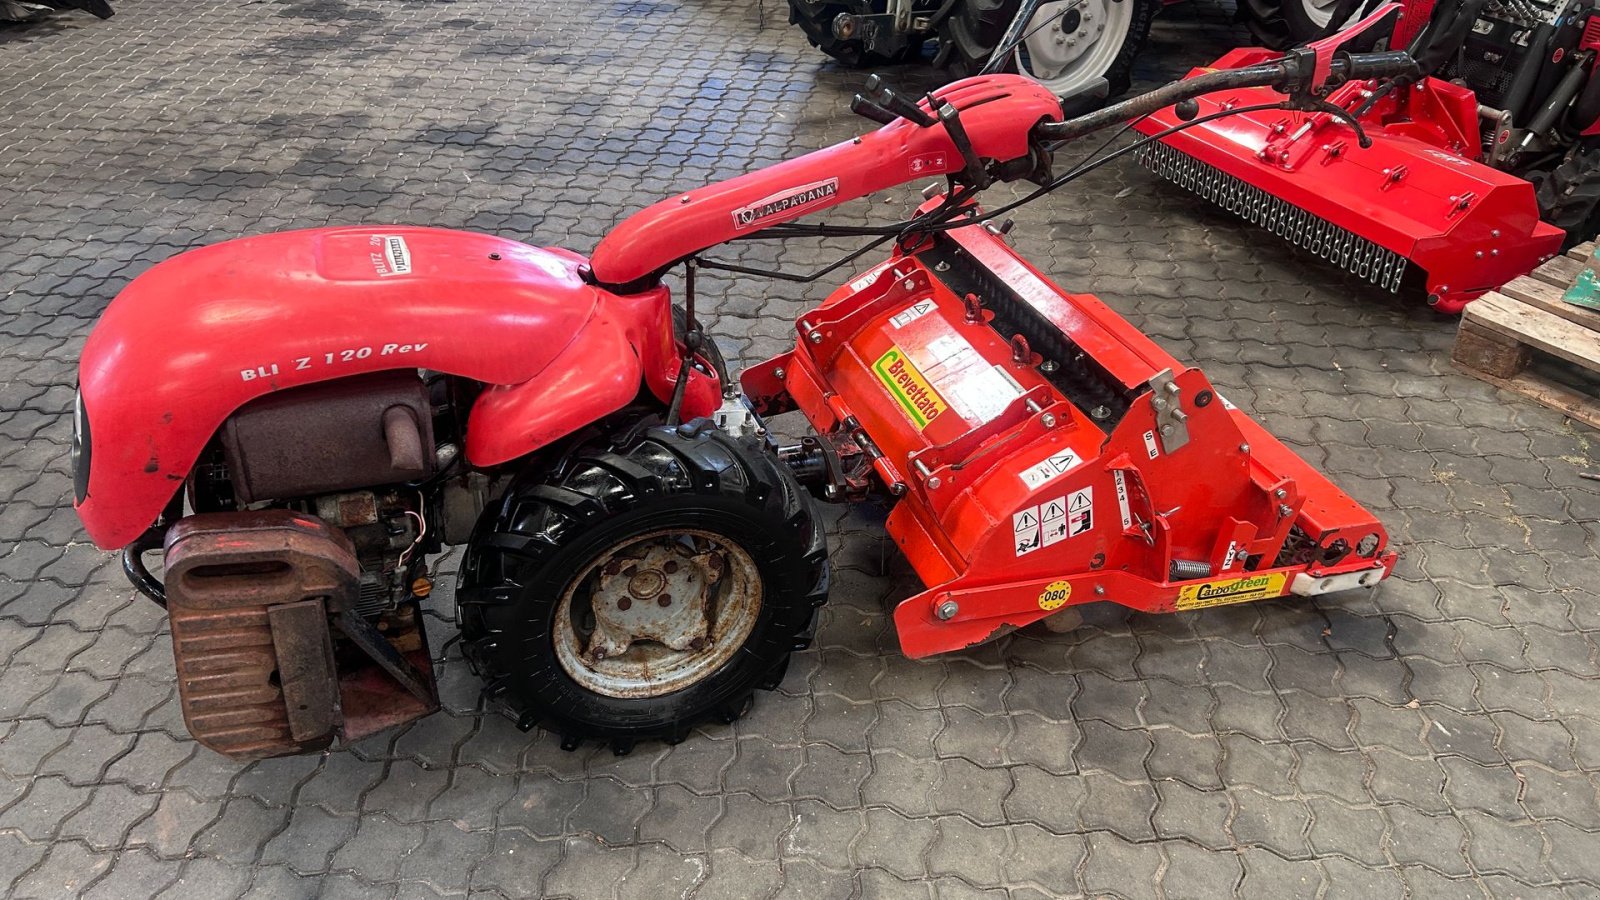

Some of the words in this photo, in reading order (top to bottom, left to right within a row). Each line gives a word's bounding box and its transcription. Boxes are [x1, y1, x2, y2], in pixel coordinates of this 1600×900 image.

[756, 184, 834, 217] VALPADANA
[370, 252, 389, 274] BLITZ
[325, 347, 372, 365] 120
[380, 343, 428, 356] Rev
[888, 358, 939, 420] Brevettato
[1044, 589, 1066, 602] 080
